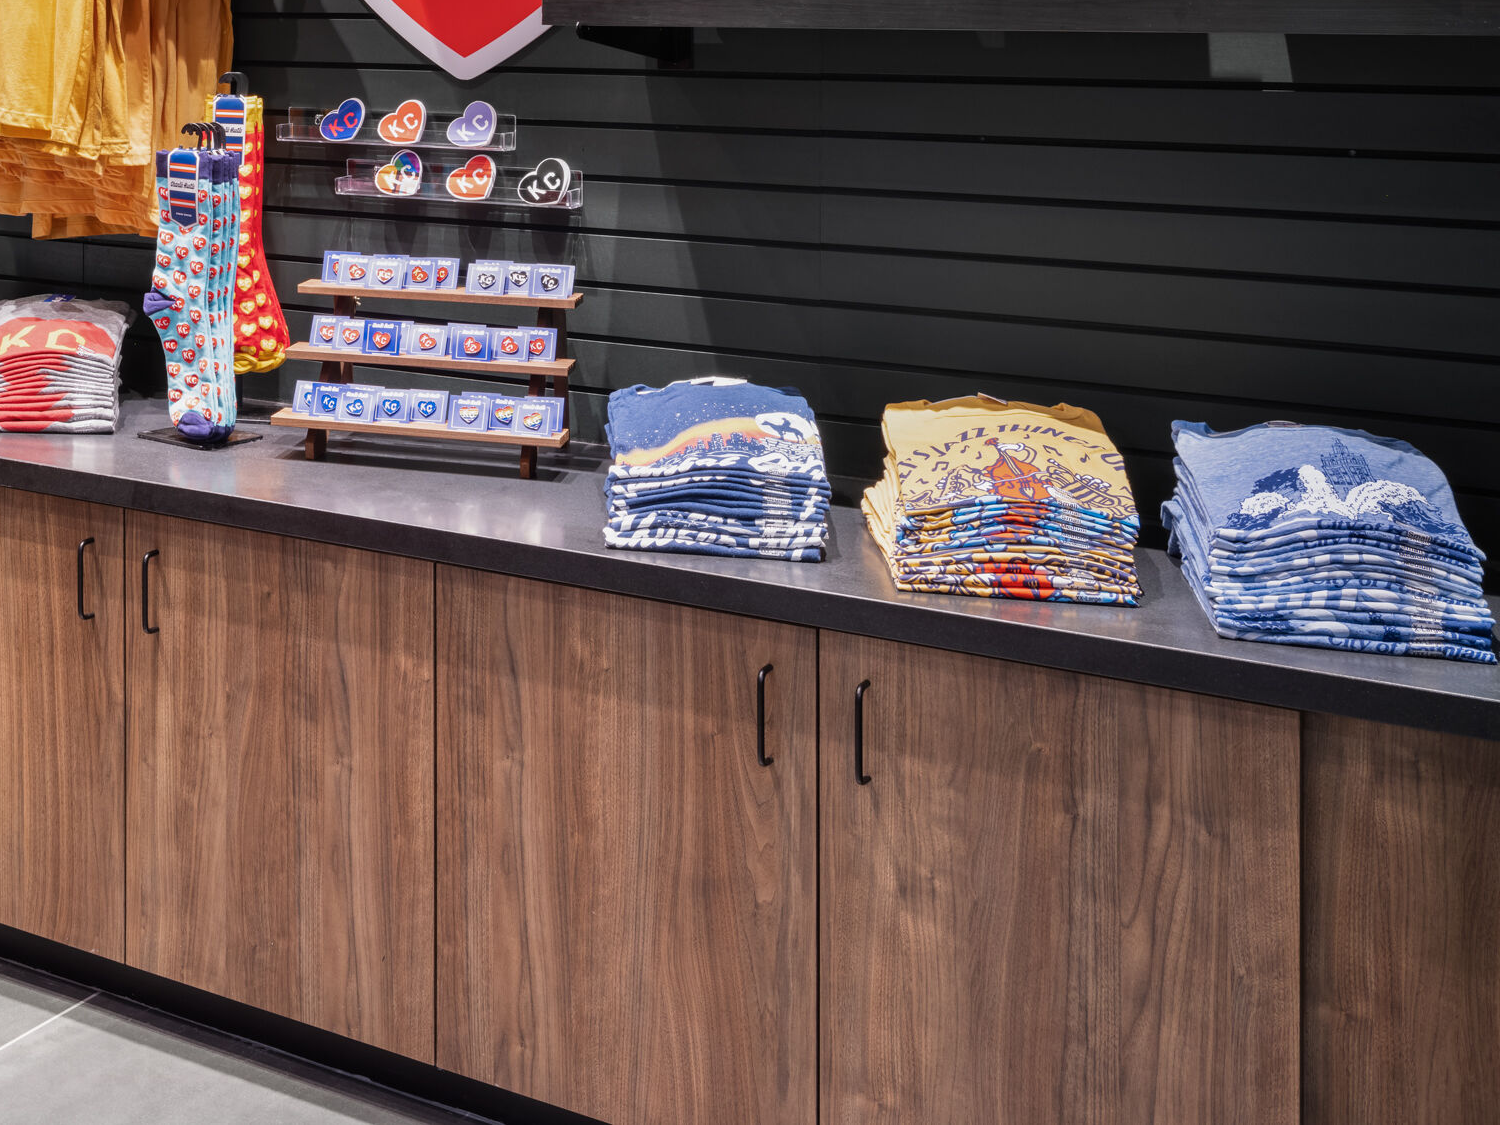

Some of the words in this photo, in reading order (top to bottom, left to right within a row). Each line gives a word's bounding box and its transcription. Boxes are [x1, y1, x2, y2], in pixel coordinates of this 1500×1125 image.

[329, 112, 358, 137] KC
[388, 113, 418, 138] KC
[456, 115, 488, 141] KC
[385, 164, 416, 190] KC
[456, 168, 488, 193] KC
[527, 172, 561, 201] KC
[322, 328, 333, 336] KC
[344, 330, 356, 340] KC
[0, 325, 86, 356] KC
[375, 335, 387, 344] KC
[420, 335, 432, 347] KC
[465, 339, 477, 351] KC
[503, 339, 514, 351] KC
[530, 342, 543, 351] KC
[322, 396, 335, 408] KC
[349, 402, 362, 413] KC
[383, 400, 397, 411] KC
[419, 402, 432, 412] KC
[900, 450, 931, 483] ET'S
[931, 427, 989, 457] JAZZ
[1408, 531, 1432, 542] Small
[1327, 636, 1371, 653] City
[1377, 642, 1396, 654] of
